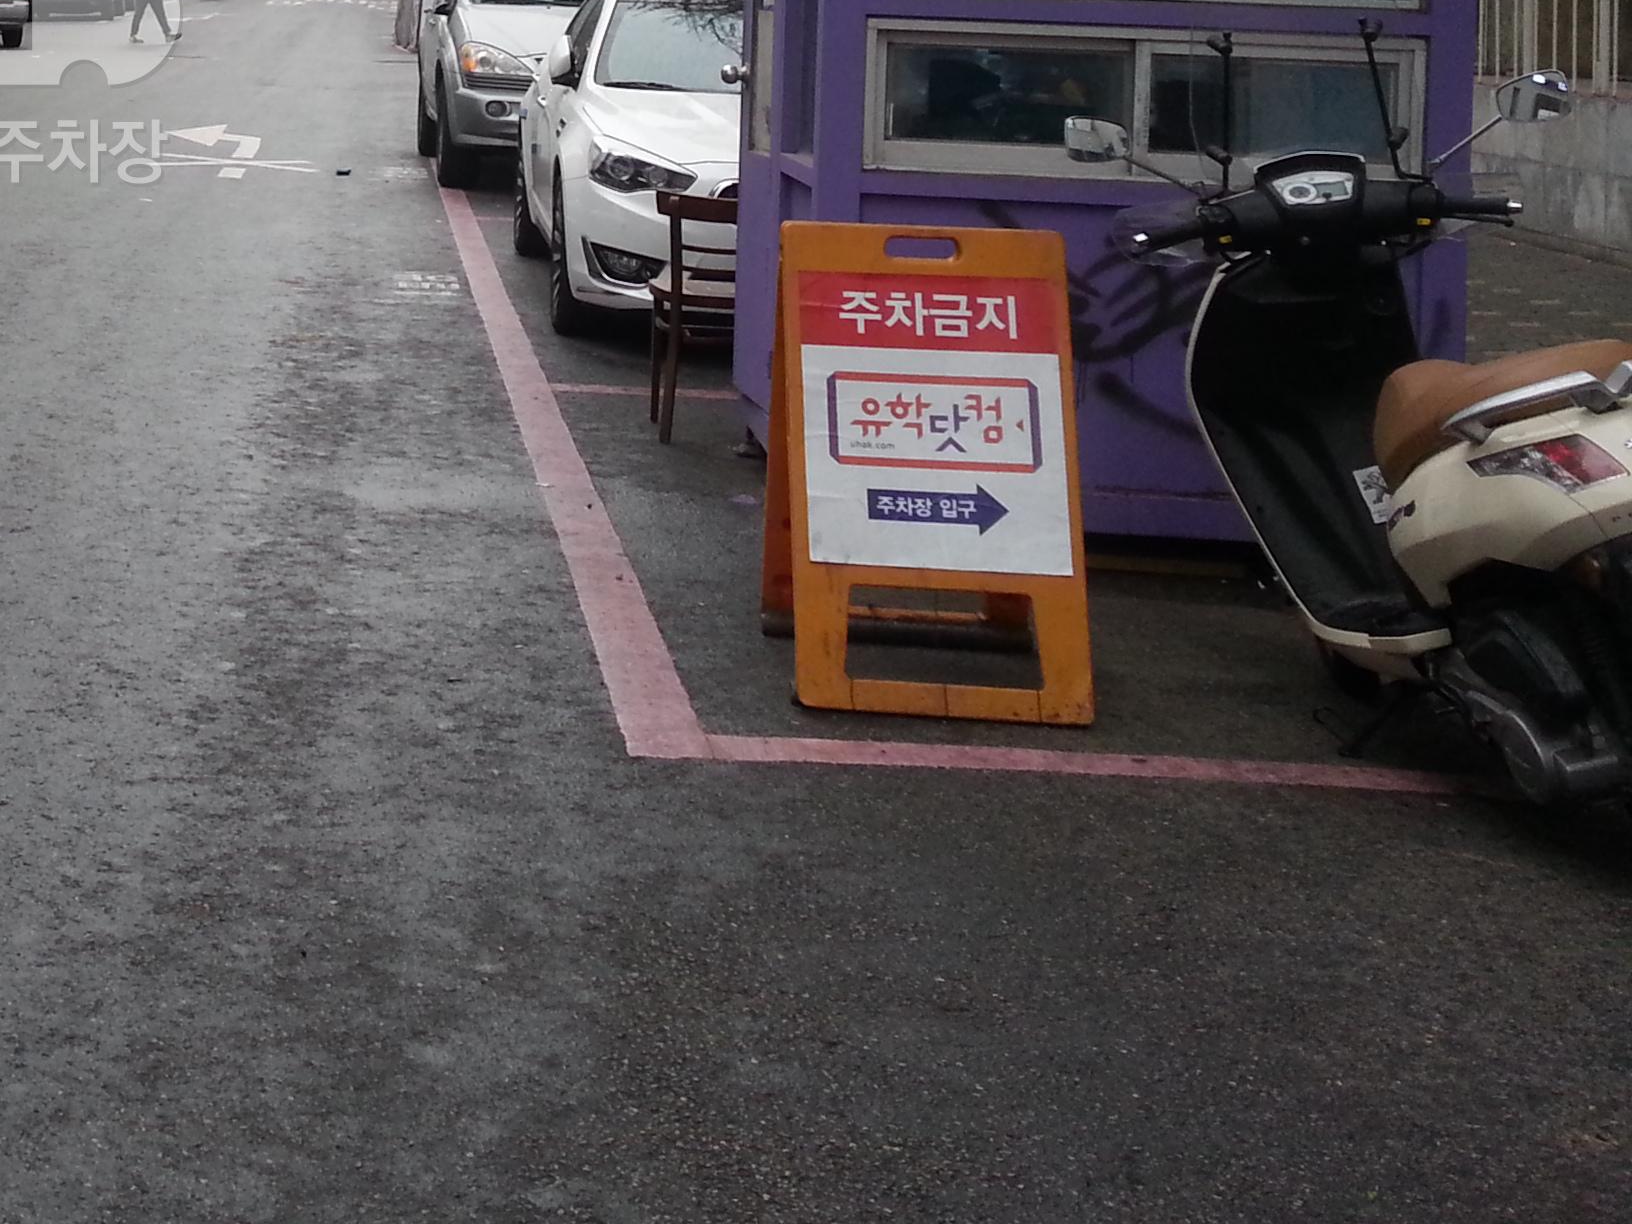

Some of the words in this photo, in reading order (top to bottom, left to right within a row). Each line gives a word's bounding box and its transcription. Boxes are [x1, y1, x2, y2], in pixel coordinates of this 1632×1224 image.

[839, 290, 1018, 340] 주차금지
[850, 392, 1005, 453] 유학닷컴
[876, 495, 933, 517] 주차장
[939, 496, 978, 519] 입구
